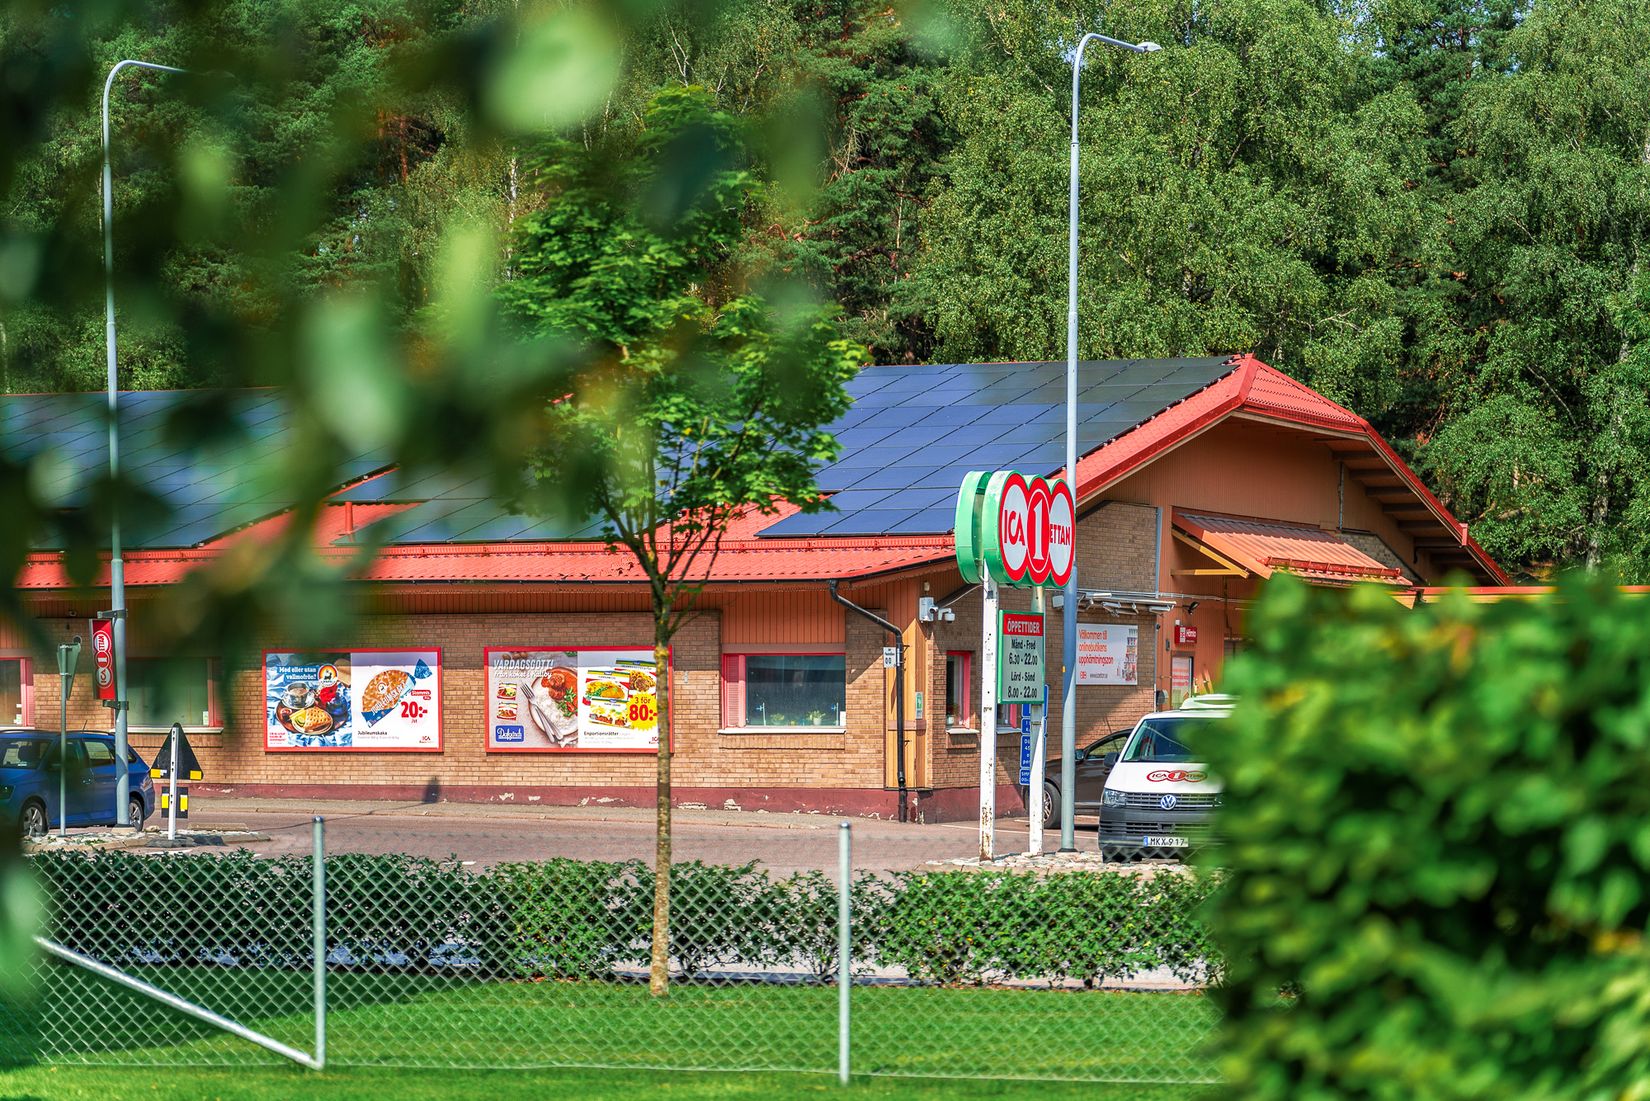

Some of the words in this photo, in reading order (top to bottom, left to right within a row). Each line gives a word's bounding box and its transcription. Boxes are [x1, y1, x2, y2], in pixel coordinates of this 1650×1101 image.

[1004, 509, 1026, 546] ICA
[1033, 499, 1044, 560] 1
[1049, 523, 1071, 546] ETTAN
[1007, 618, 1040, 633] ÖPPETTIDER
[1011, 638, 1023, 650] Månd
[1026, 640, 1036, 650] Fred
[493, 659, 554, 670] VARDAGSGOTT!
[1008, 652, 1020, 665] 6.30
[1024, 653, 1038, 665] 22.00
[1010, 671, 1022, 681] Lörd
[1024, 672, 1036, 682] Sönd
[1007, 686, 1019, 698] 8.00
[1023, 686, 1038, 698] 22.00
[641, 696, 651, 704] för
[401, 701, 428, 718] 20:-
[1150, 837, 1165, 846] MKX
[1168, 838, 1185, 846] 917
